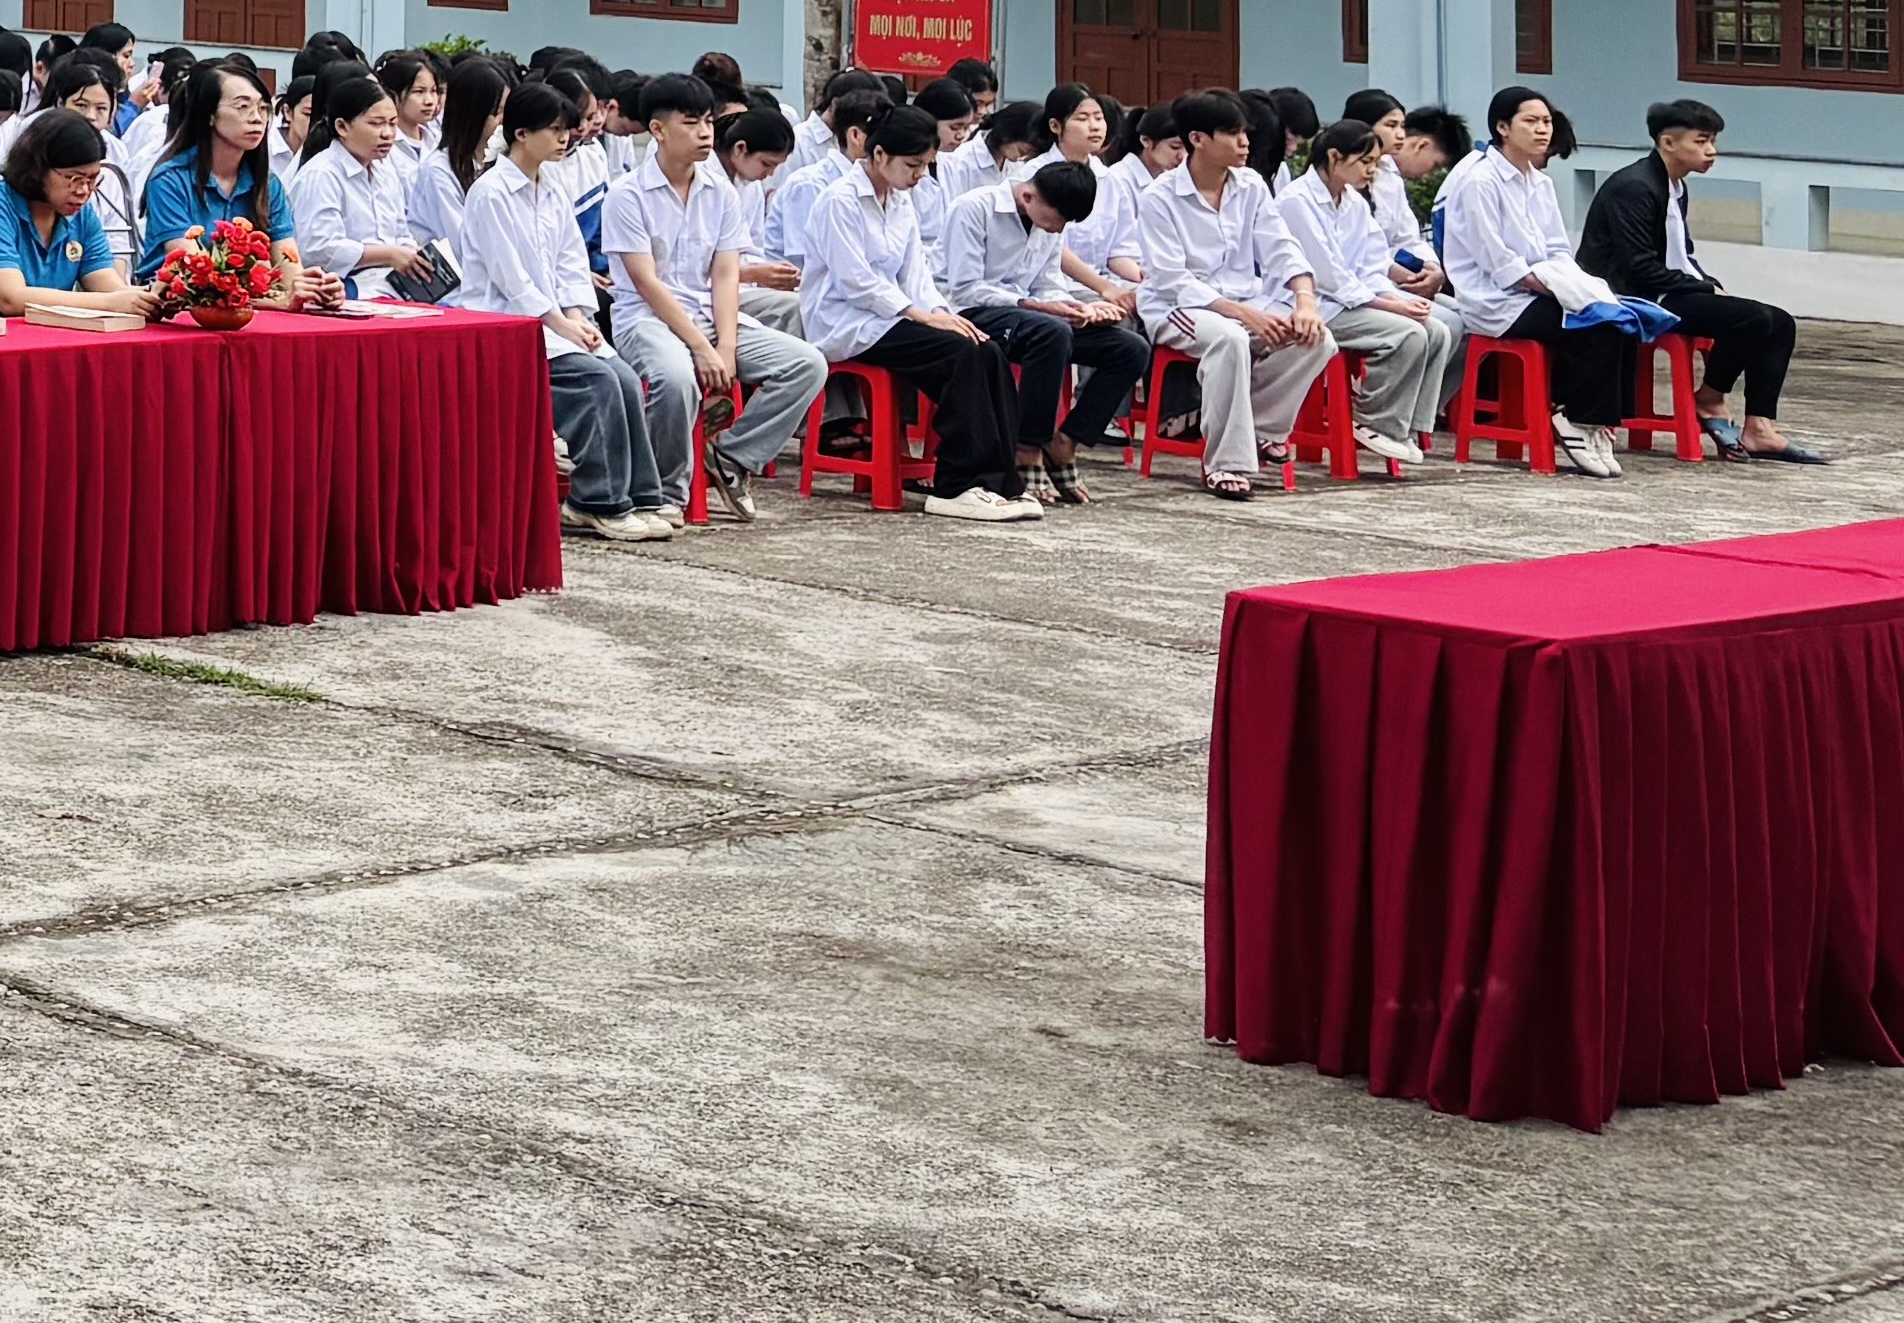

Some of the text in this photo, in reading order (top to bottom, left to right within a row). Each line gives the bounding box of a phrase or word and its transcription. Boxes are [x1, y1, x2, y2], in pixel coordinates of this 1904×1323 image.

[870, 15, 892, 40] MỌI
[896, 15, 920, 41] NƠI,
[923, 17, 946, 43] MỌI
